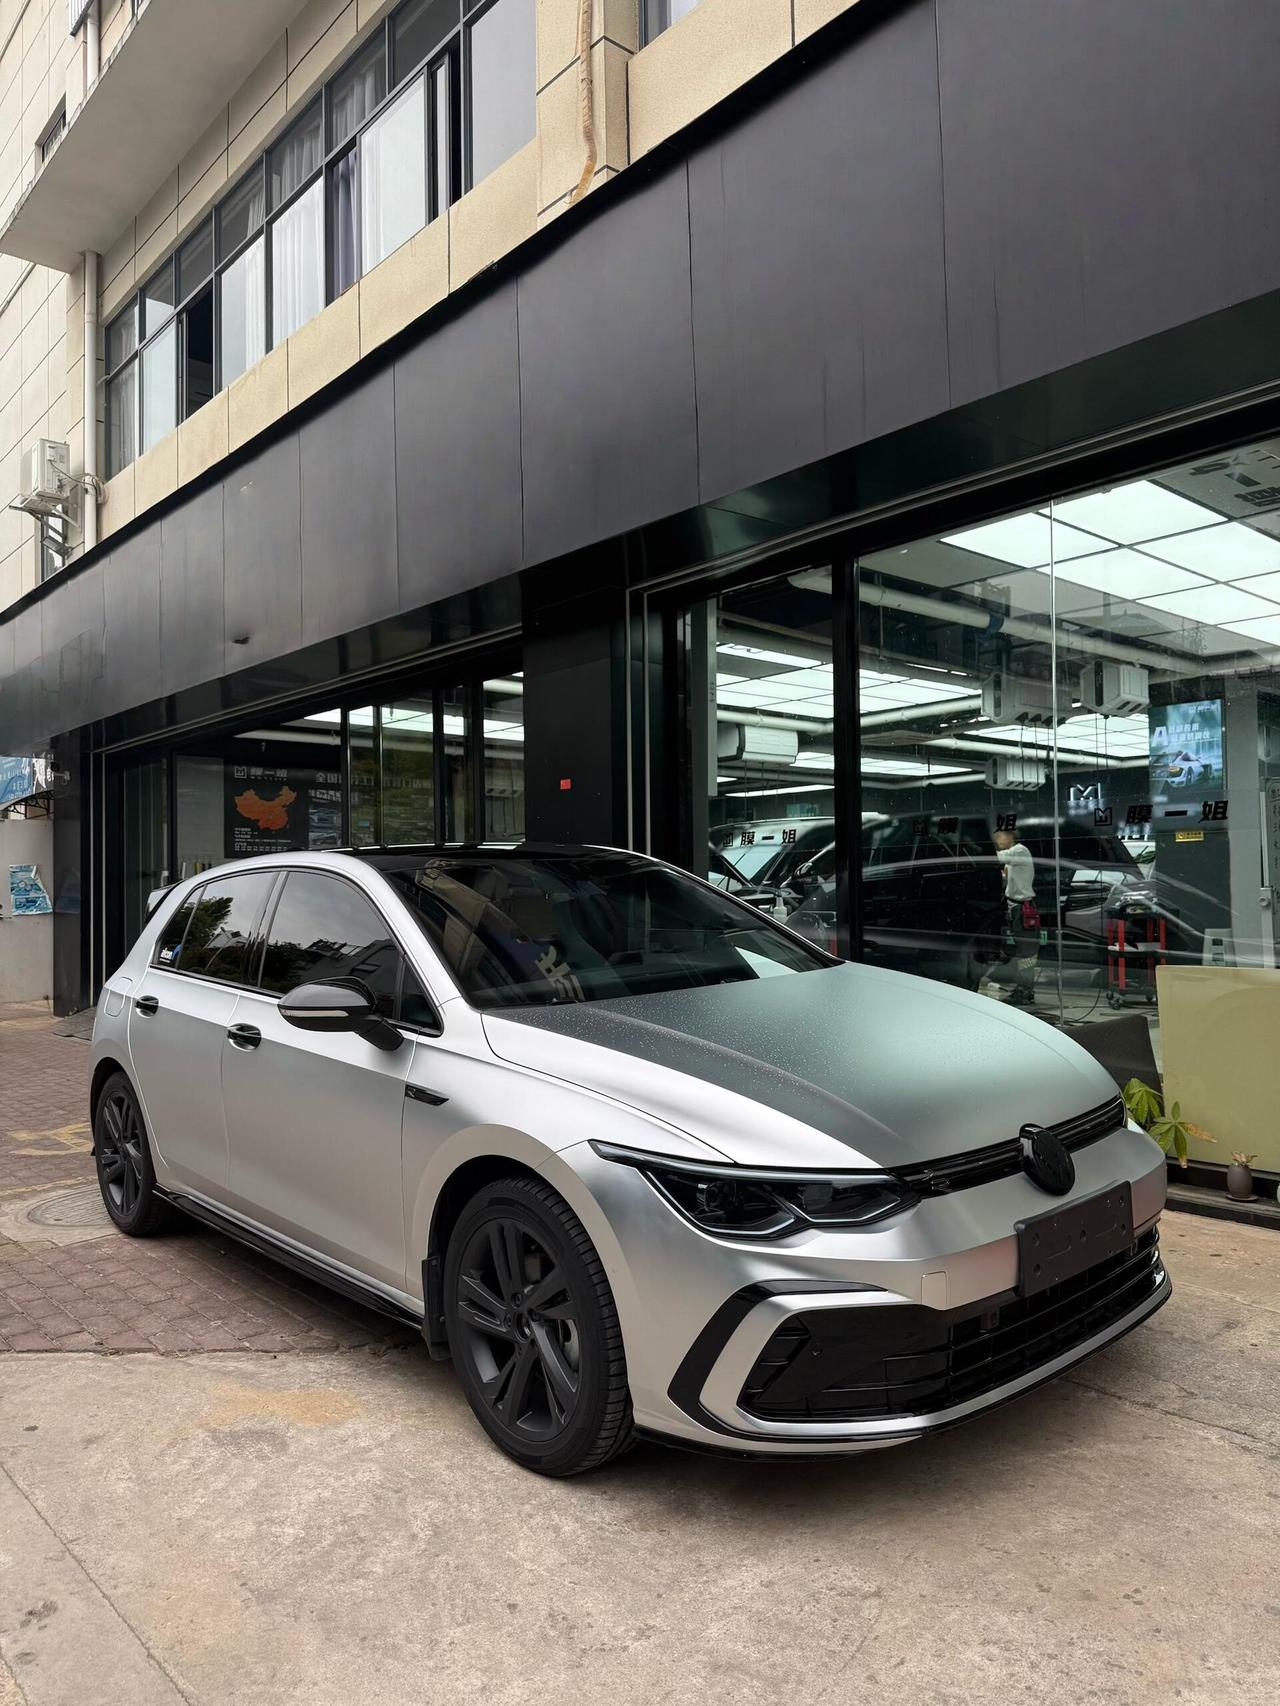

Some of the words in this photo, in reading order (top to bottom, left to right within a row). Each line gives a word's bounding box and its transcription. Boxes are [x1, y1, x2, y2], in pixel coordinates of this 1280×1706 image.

[1125, 800, 1229, 825] 膜一姐
[740, 828, 797, 847] 膜一姐
